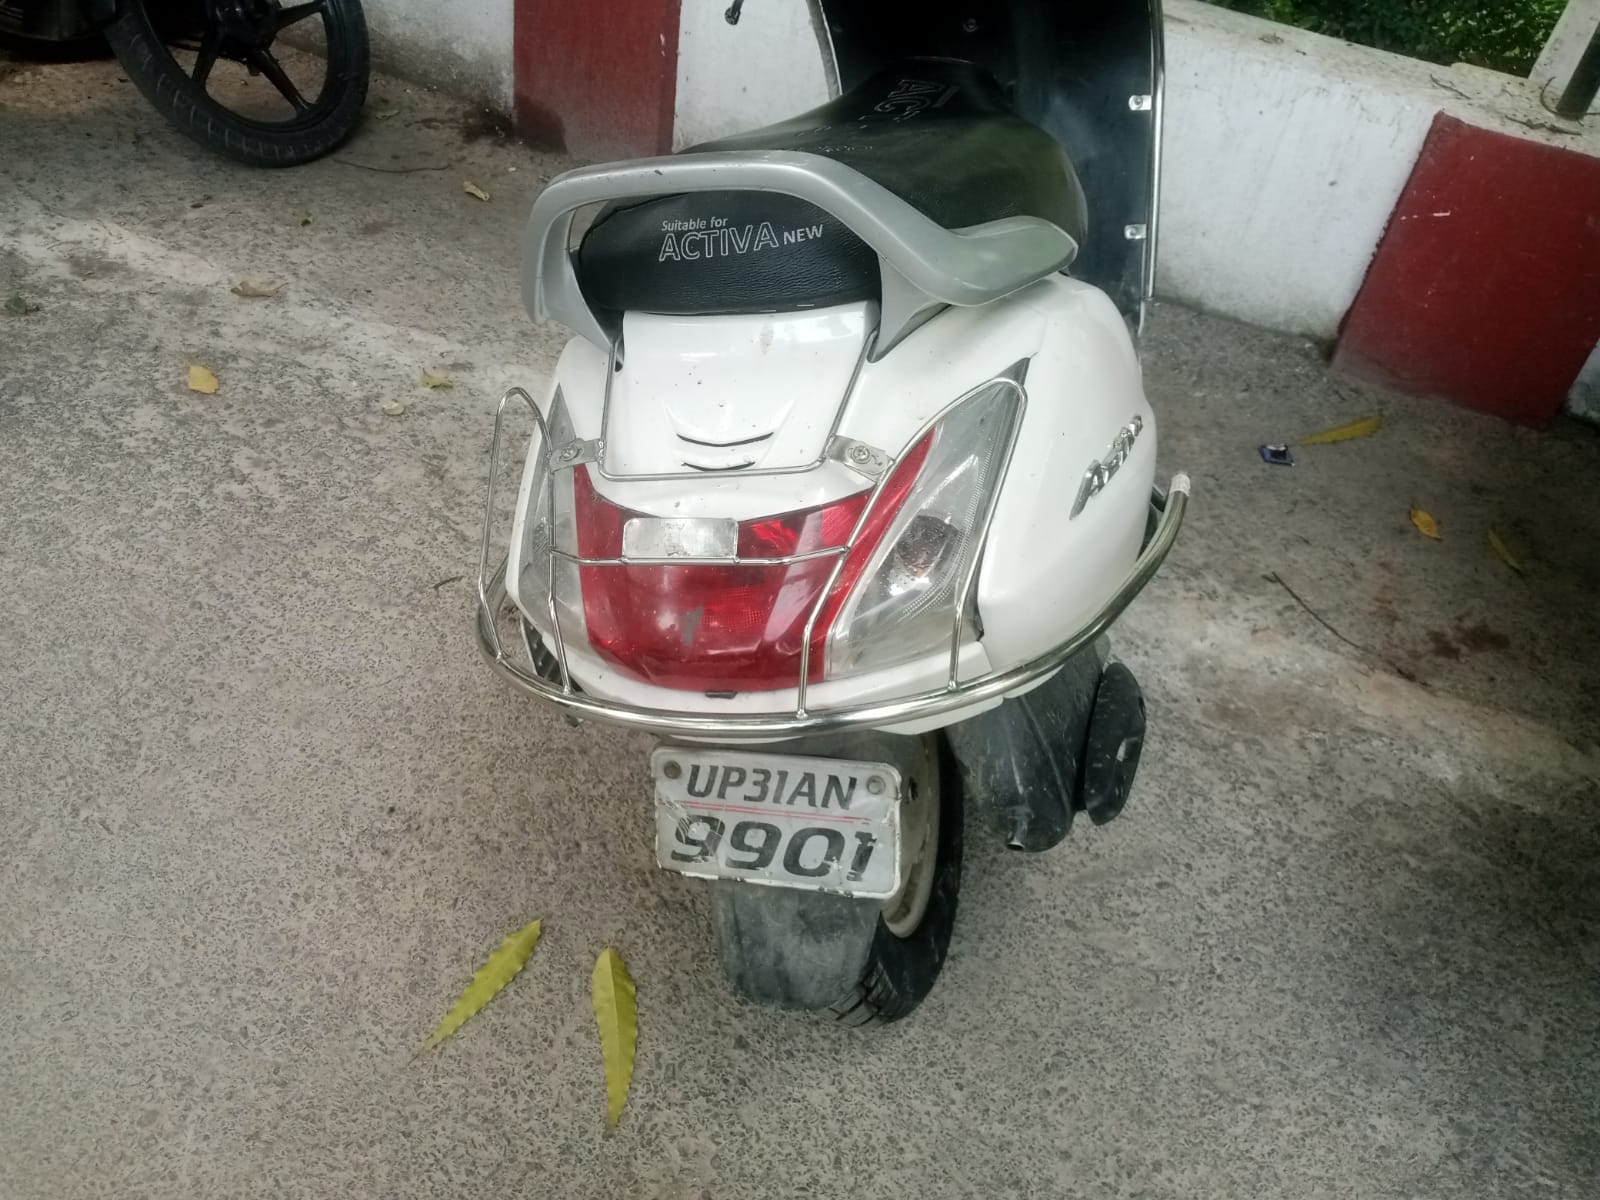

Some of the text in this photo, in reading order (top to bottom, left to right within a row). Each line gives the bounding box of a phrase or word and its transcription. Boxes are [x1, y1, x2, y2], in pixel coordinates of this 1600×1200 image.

[658, 222, 823, 261] ACTIVA NEW
[661, 216, 728, 232] Suitable for
[687, 764, 857, 810] UP31AN
[670, 814, 877, 881] 9901
